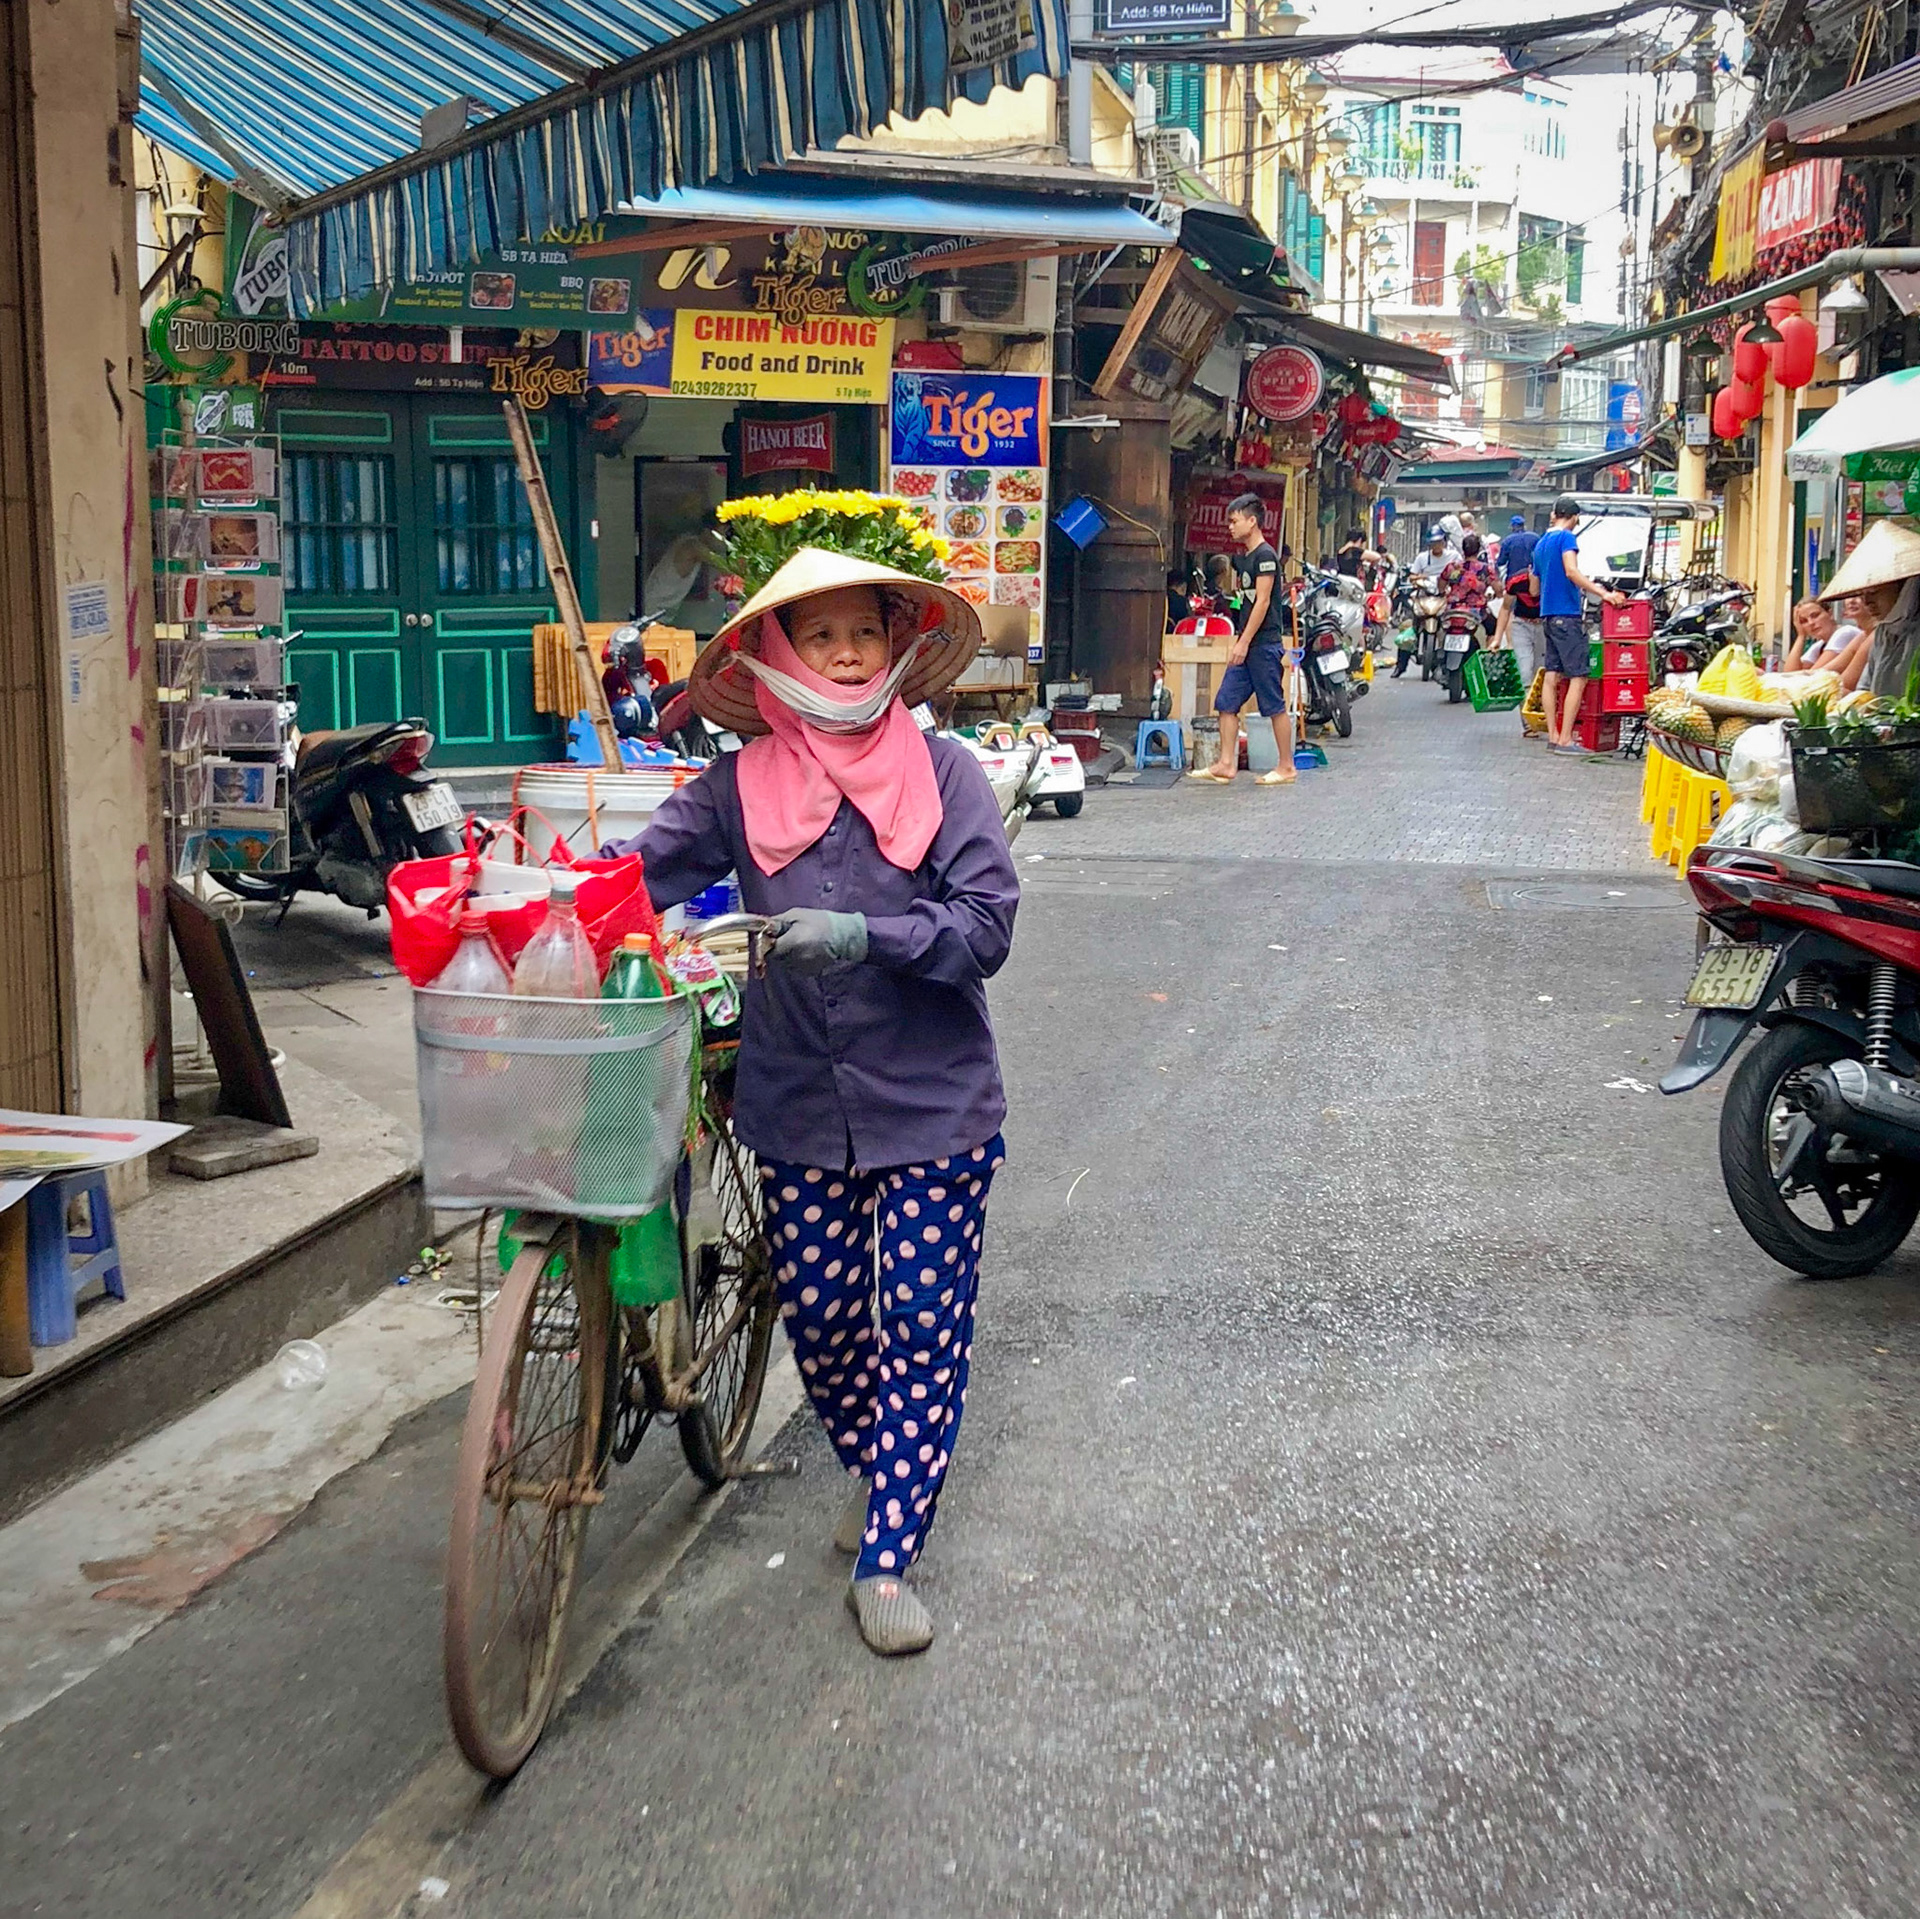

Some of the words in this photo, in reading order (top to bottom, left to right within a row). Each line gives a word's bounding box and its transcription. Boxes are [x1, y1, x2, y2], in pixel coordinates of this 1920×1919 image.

[1121, 5, 1150, 19] Add:
[1153, 5, 1167, 18] 5B
[502, 250, 518, 263] 5B
[561, 276, 584, 289] BBQ
[754, 273, 846, 327] Tiger
[170, 318, 300, 354] TUBORG
[695, 315, 772, 344] CHIM
[781, 316, 878, 347] NƯỚNG
[301, 338, 416, 362] TATTOO
[592, 326, 671, 369] Tiger
[281, 362, 308, 374] 10m
[701, 351, 752, 372] Food
[760, 354, 799, 374] and
[806, 354, 864, 376] Drink
[486, 354, 589, 410] Tiger
[672, 380, 757, 399] 02439282337
[922, 391, 1034, 457] Tiger
[747, 425, 791, 454] HANOI
[794, 422, 827, 450] BEER
[933, 439, 957, 449] SINCE
[994, 440, 1015, 449] 1932
[416, 804, 461, 829] 150.19
[1694, 978, 1752, 1002] 6551
